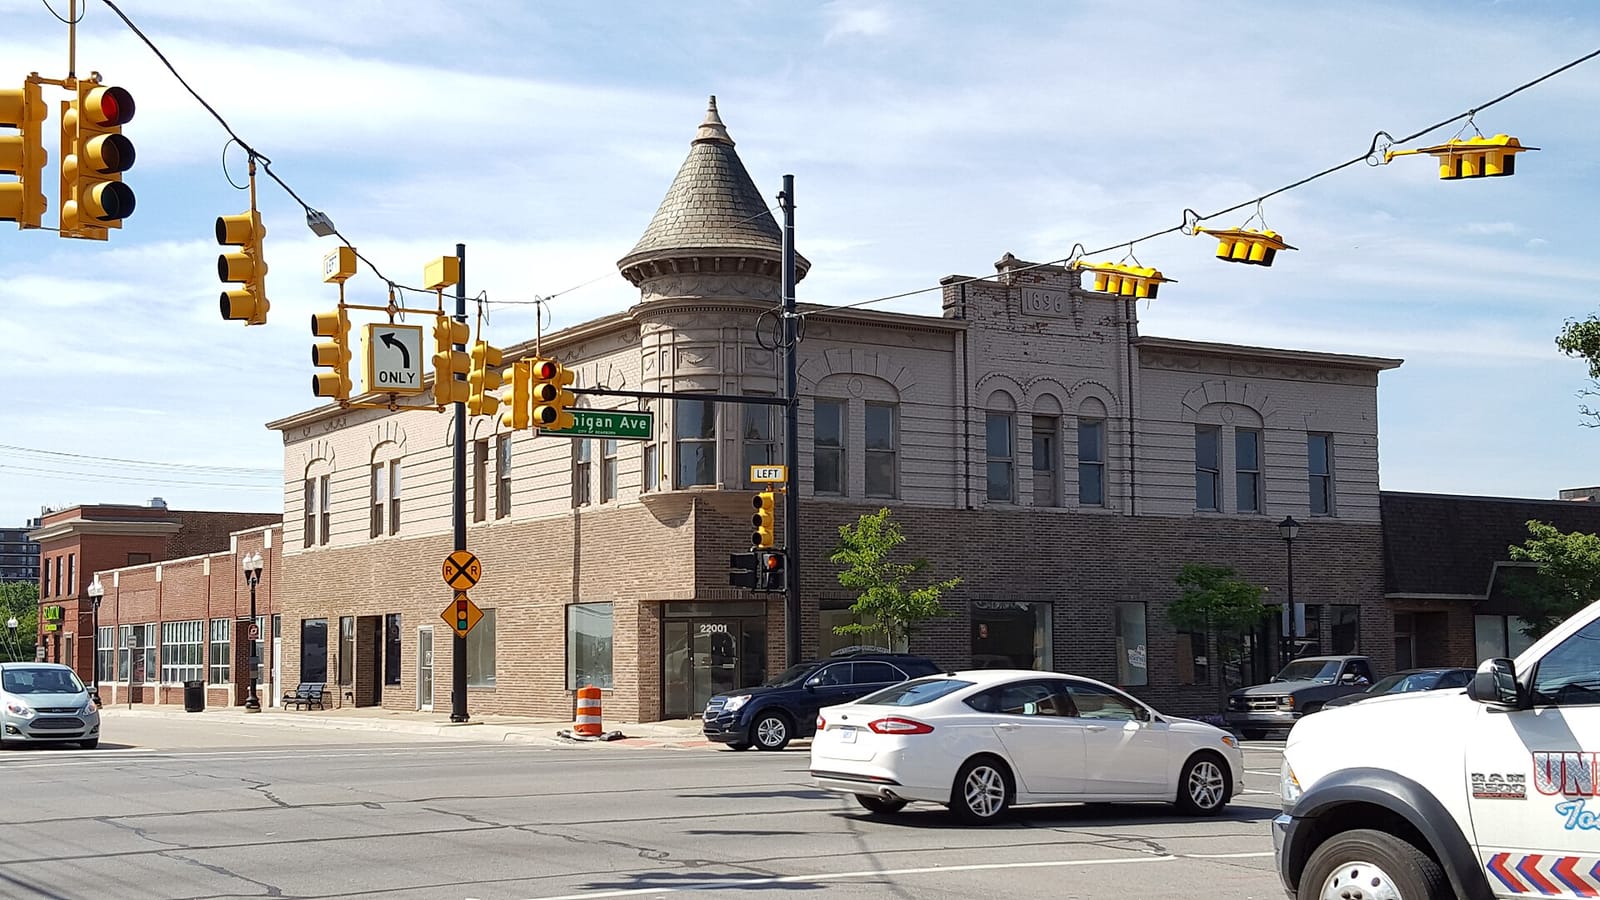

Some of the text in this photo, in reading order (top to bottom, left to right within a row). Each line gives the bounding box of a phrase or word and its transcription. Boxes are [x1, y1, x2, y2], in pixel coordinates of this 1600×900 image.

[1025, 290, 1063, 313] 1896
[379, 371, 416, 384] ONLY
[573, 413, 647, 432] higan Ave
[756, 469, 779, 479] LEFT
[445, 565, 478, 576] R R
[700, 624, 728, 633] 22001
[1471, 773, 1526, 783] RAM
[1532, 751, 1600, 797] UN
[1555, 797, 1600, 831] To
